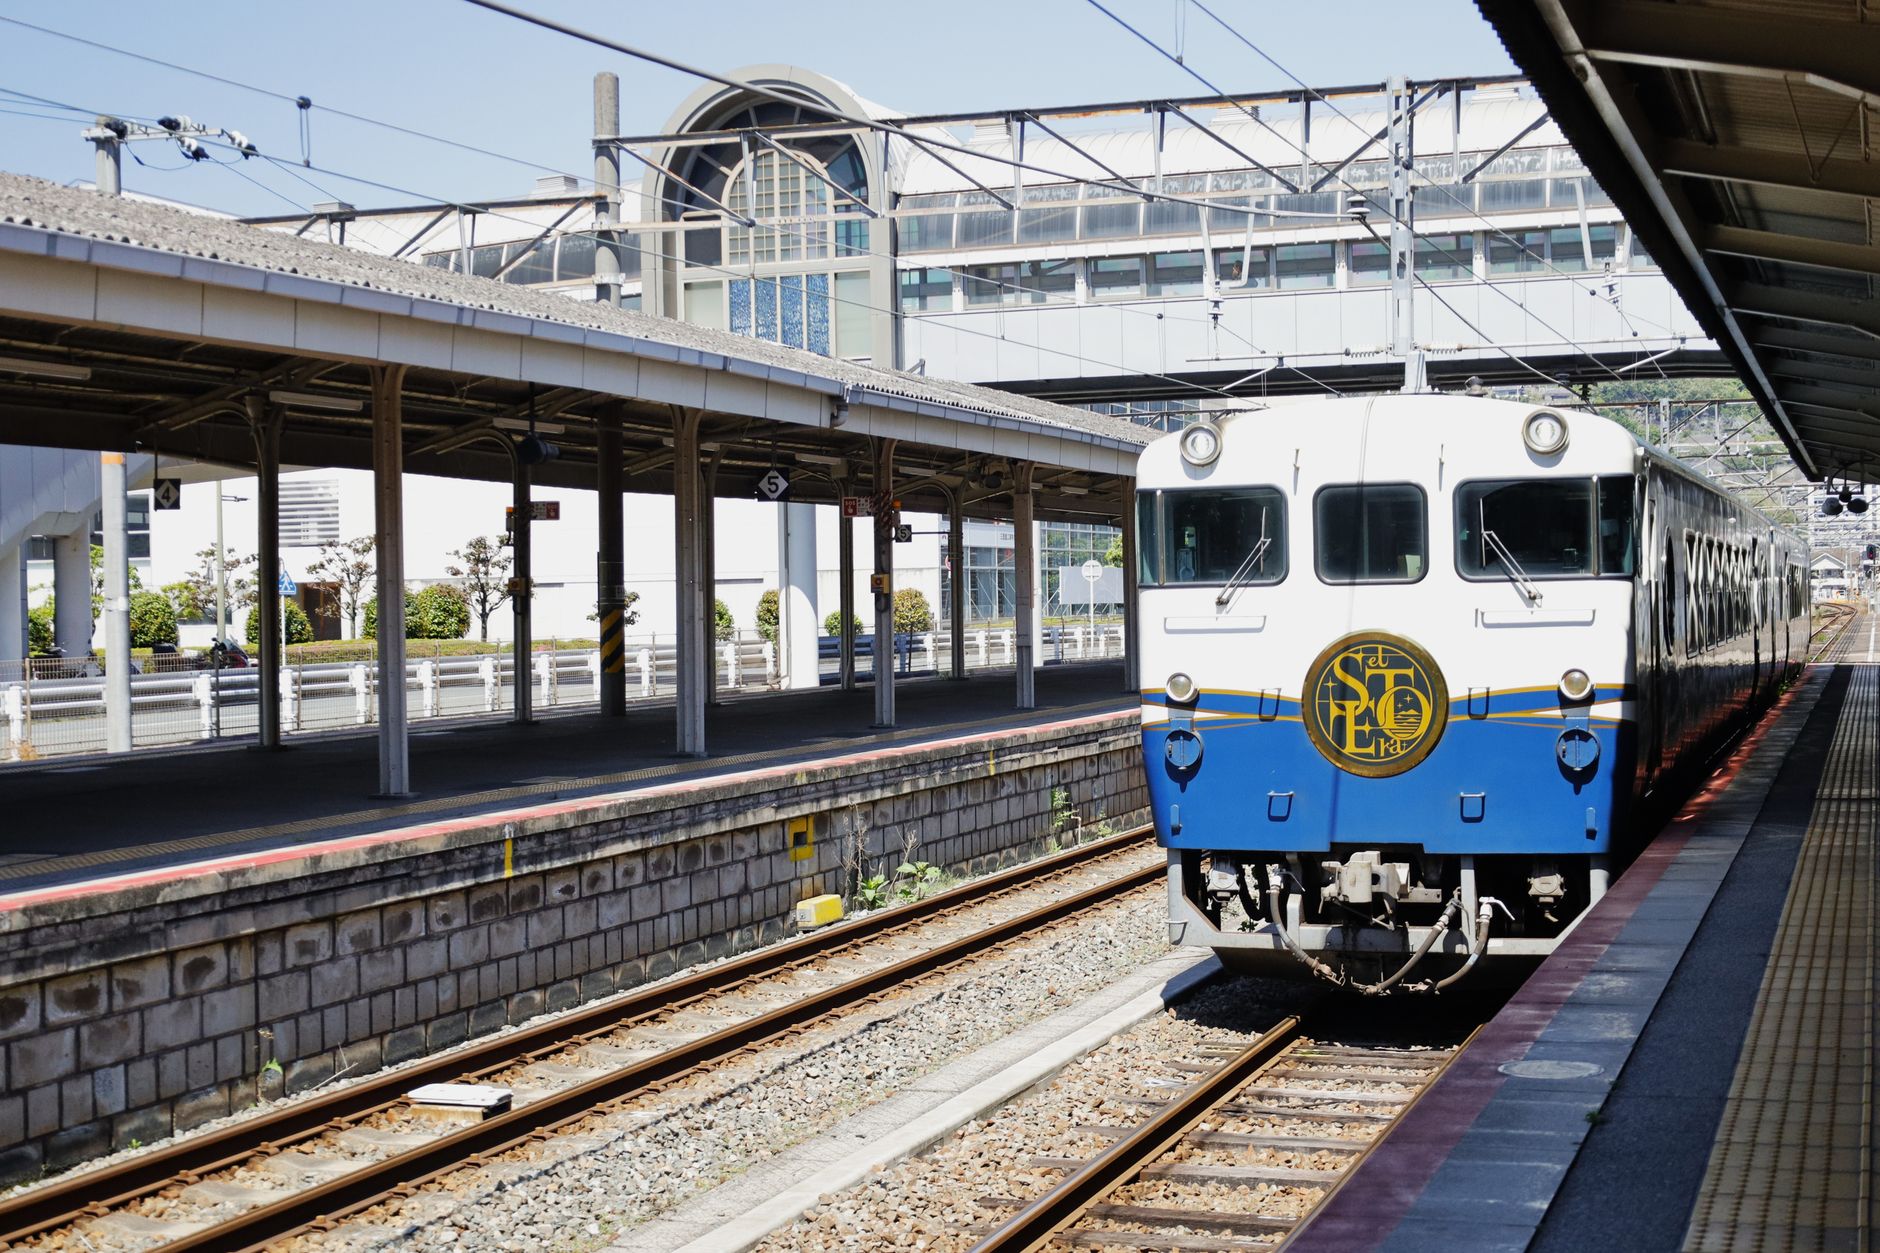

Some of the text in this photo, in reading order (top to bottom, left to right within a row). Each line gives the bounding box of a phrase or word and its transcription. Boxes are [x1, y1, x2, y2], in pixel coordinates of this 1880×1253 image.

[767, 476, 779, 493] 5
[161, 486, 171, 503] 4
[900, 528, 907, 538] 5
